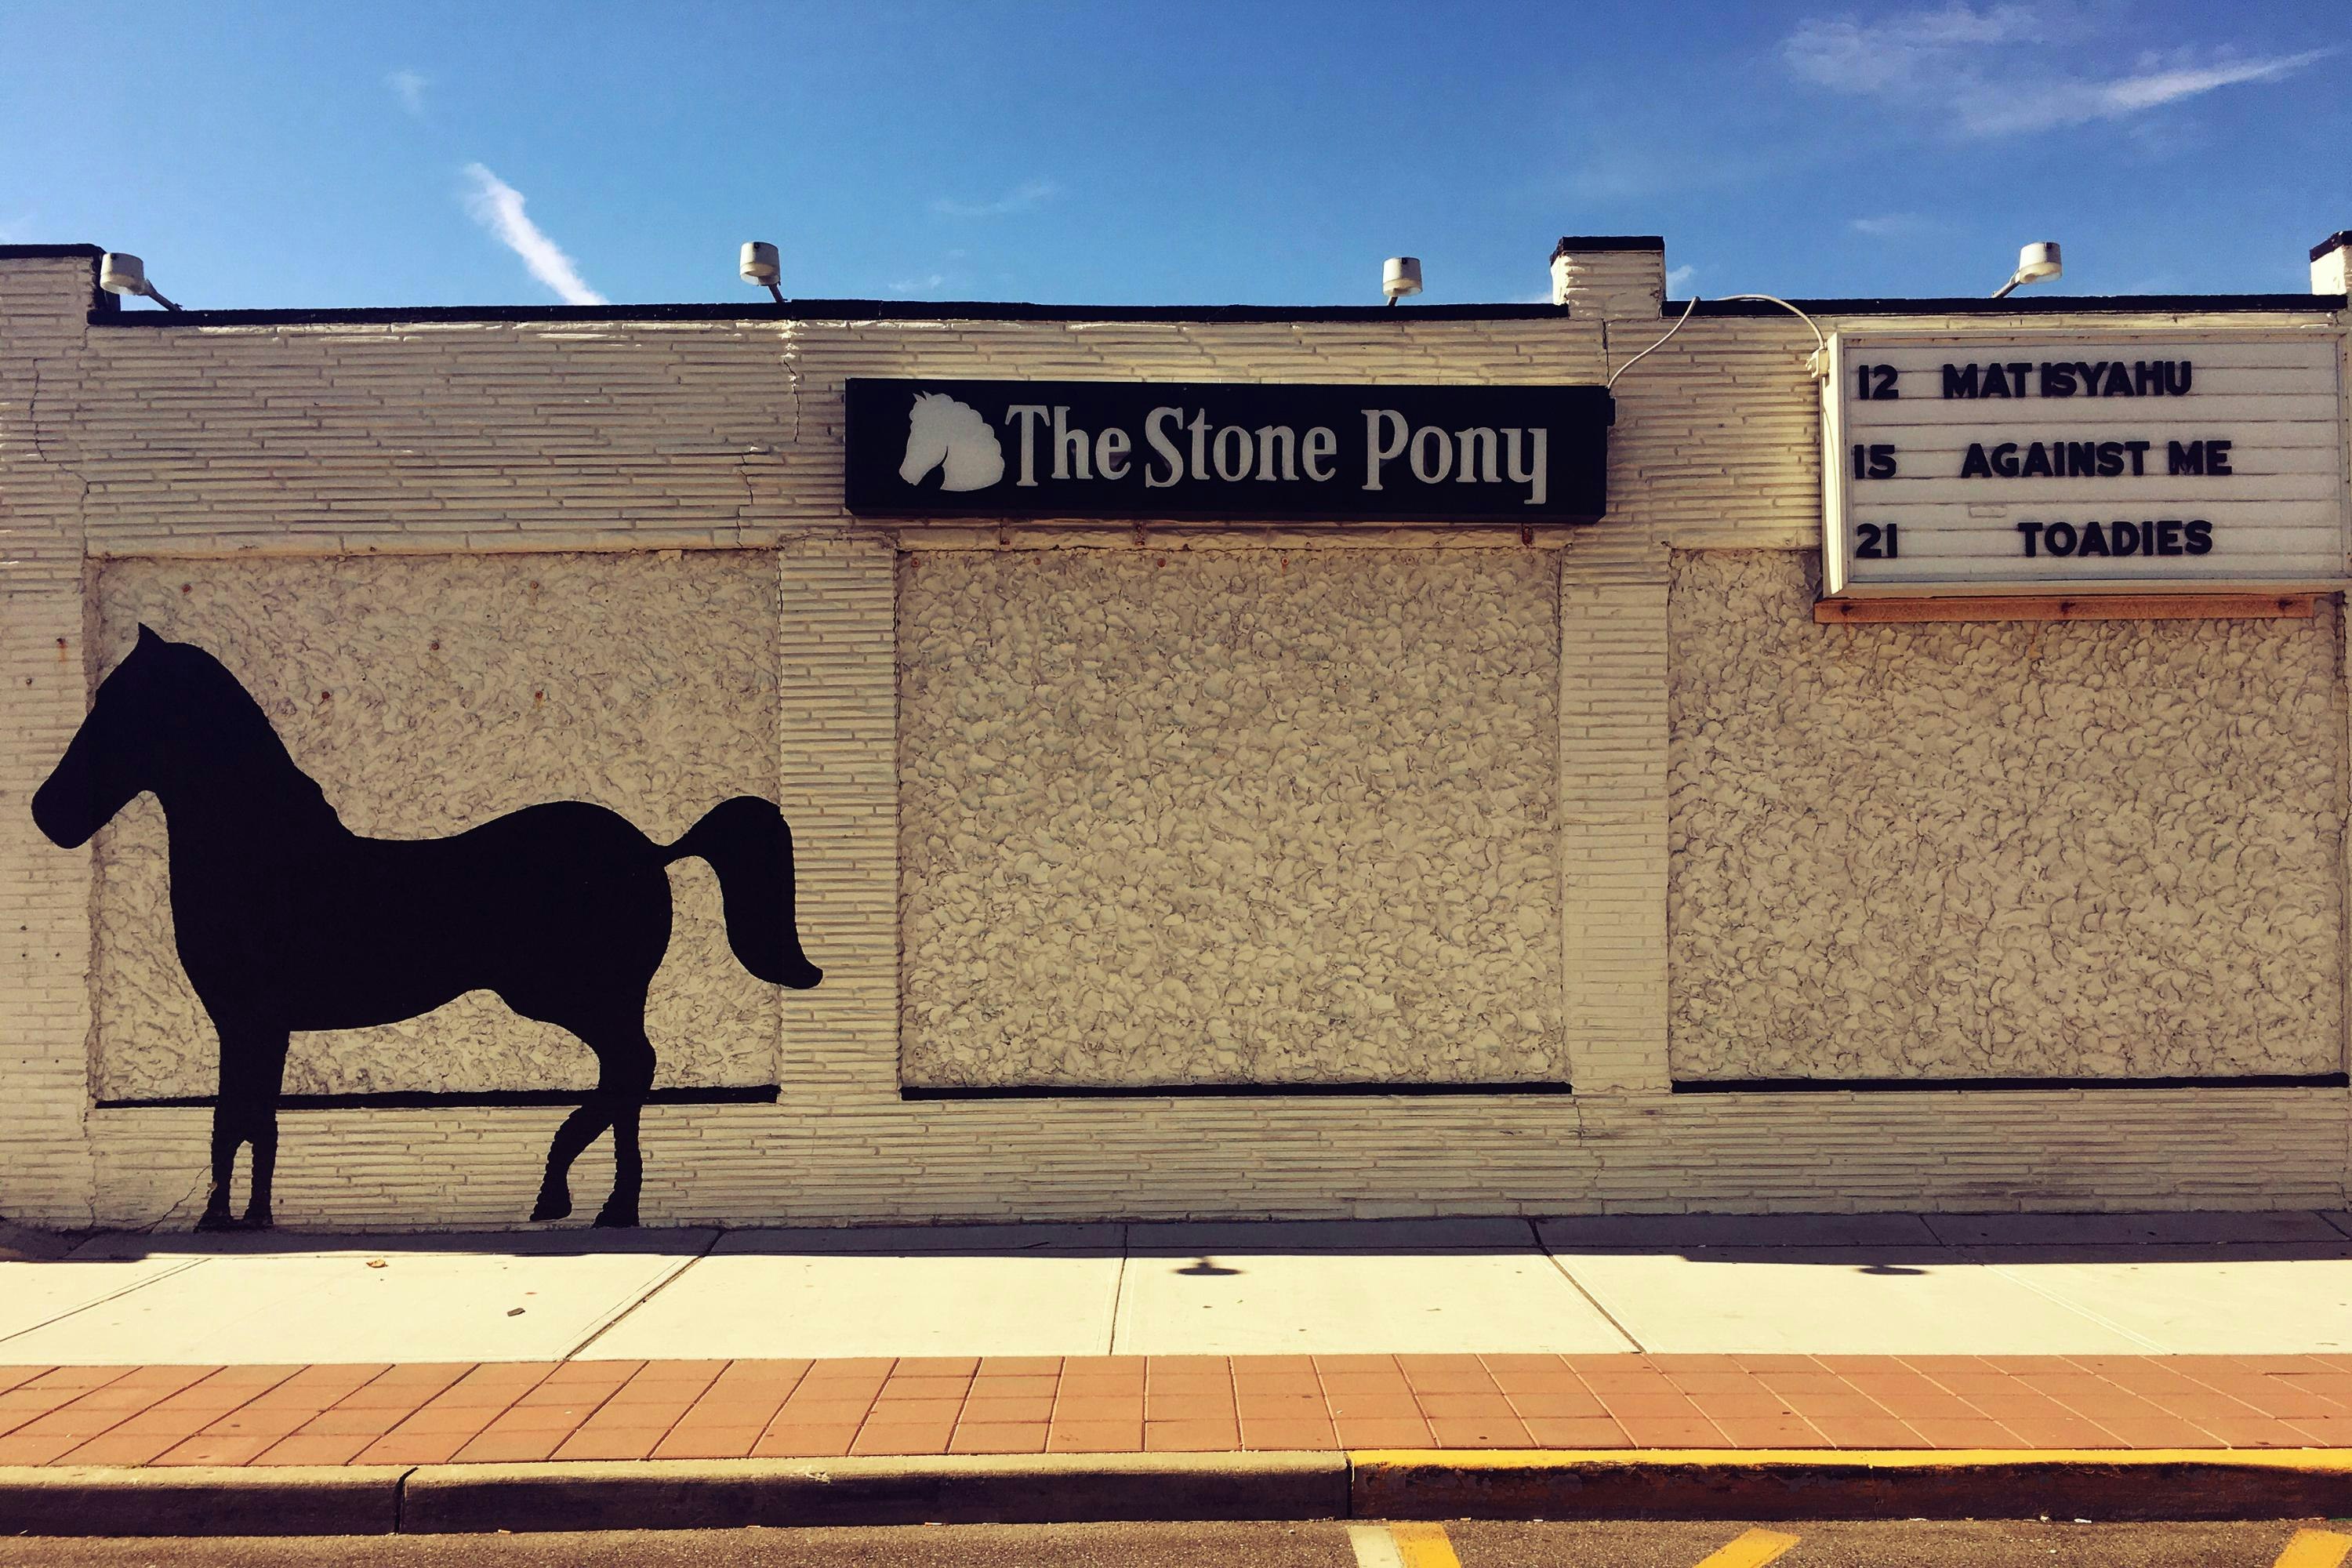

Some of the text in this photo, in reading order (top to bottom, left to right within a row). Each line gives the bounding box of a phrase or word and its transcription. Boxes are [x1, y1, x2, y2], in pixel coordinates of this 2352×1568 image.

[1859, 361, 2191, 400] 12 MATISYAHU
[1006, 405, 1546, 503] The Stone Pony
[1854, 441, 2232, 480] 15 AGAINST ME
[1856, 521, 2212, 559] 21 TOADIES
